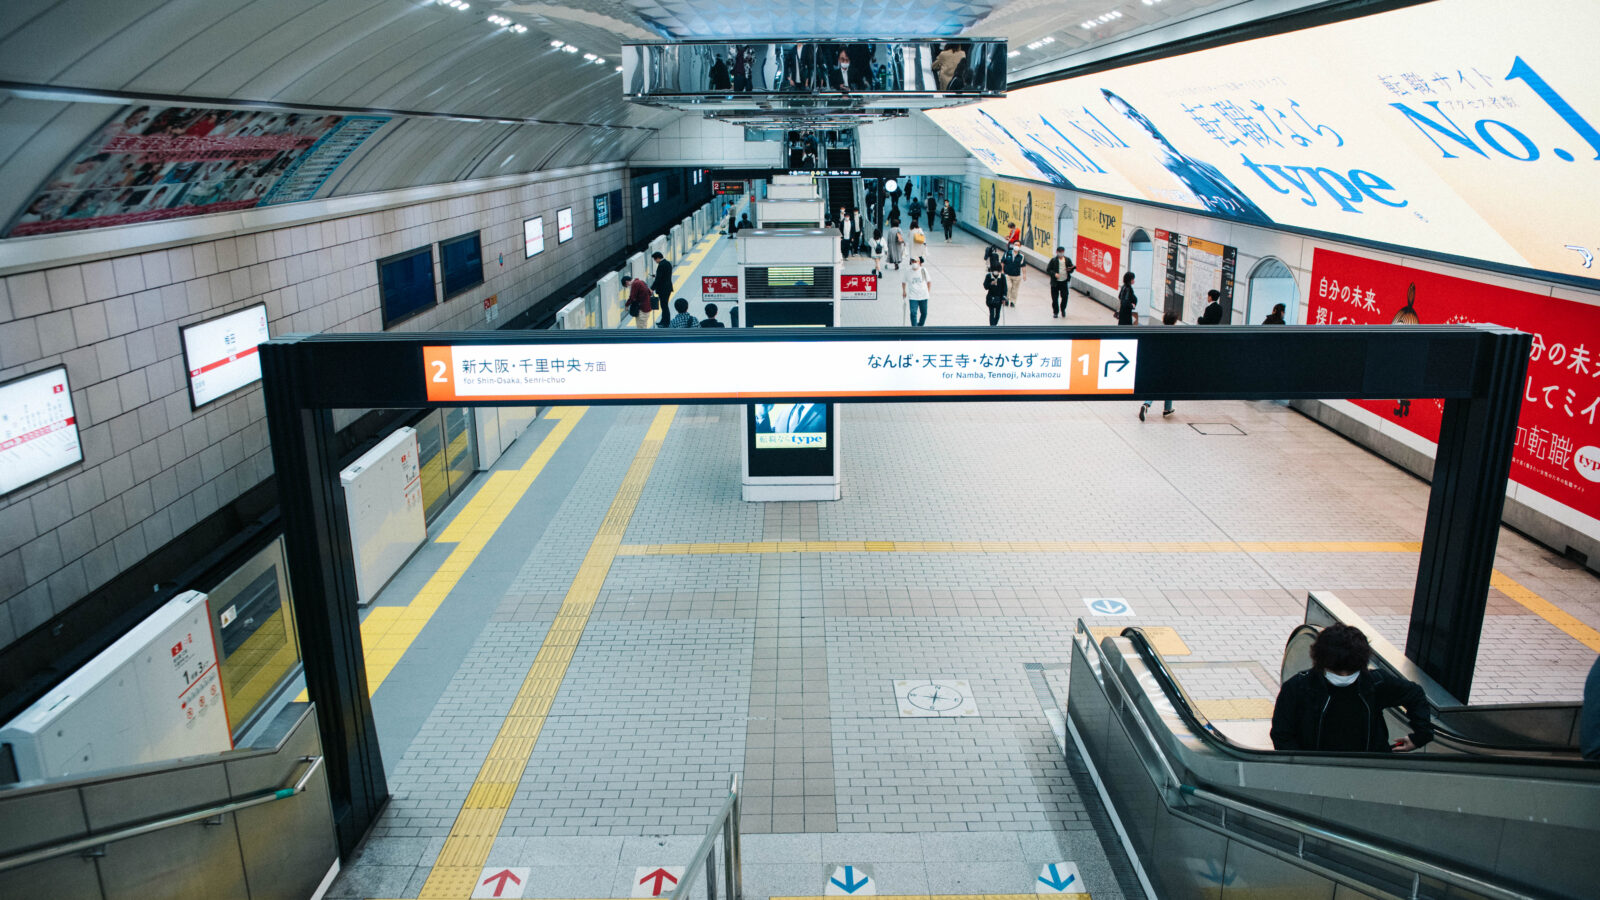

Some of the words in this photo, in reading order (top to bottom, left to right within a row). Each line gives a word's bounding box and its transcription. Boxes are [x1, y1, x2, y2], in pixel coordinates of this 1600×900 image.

[1377, 67, 1494, 96] 転職サイト
[1181, 98, 1344, 149] 転職なら
[1241, 152, 1408, 214] type
[1099, 210, 1116, 230] type
[1034, 225, 1051, 248] type
[1318, 276, 1381, 315] 自分の未来、
[431, 360, 448, 383] 2
[942, 371, 954, 379] for
[956, 371, 986, 380] Namba,
[988, 371, 1019, 380] Tennoji,
[1020, 371, 1062, 379] Nakamozu
[1077, 353, 1090, 376] 1
[463, 376, 475, 385] for
[477, 376, 522, 386] Shin-Osaka,
[524, 375, 566, 384] Senri-chuo
[791, 435, 823, 445] type
